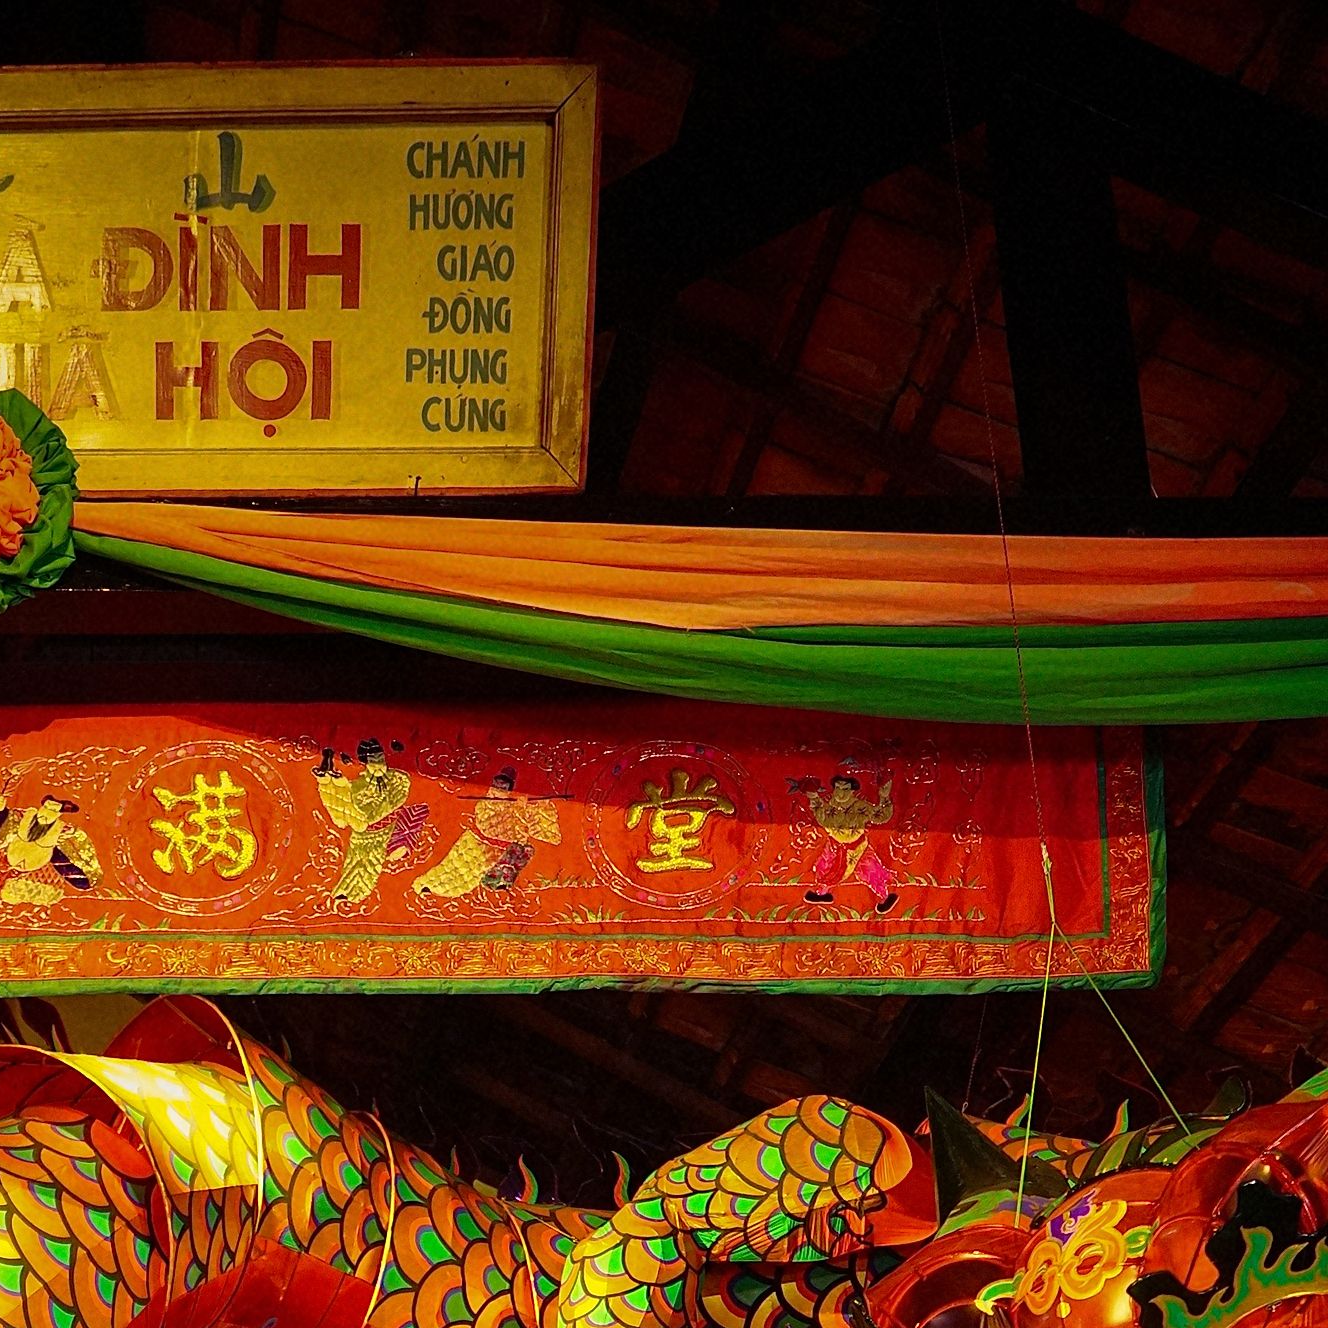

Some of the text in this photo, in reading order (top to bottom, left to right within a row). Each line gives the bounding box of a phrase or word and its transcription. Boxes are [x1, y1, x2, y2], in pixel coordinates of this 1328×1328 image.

[184, 131, 277, 214] 山
[406, 133, 525, 179] CHÁNH
[90, 212, 362, 312] ĐÌNH
[436, 240, 515, 282] GIÁO
[422, 288, 511, 334] ĐỒNG
[155, 328, 332, 438] HỘI
[405, 348, 508, 389] PHỤNG
[627, 770, 735, 873] 堂
